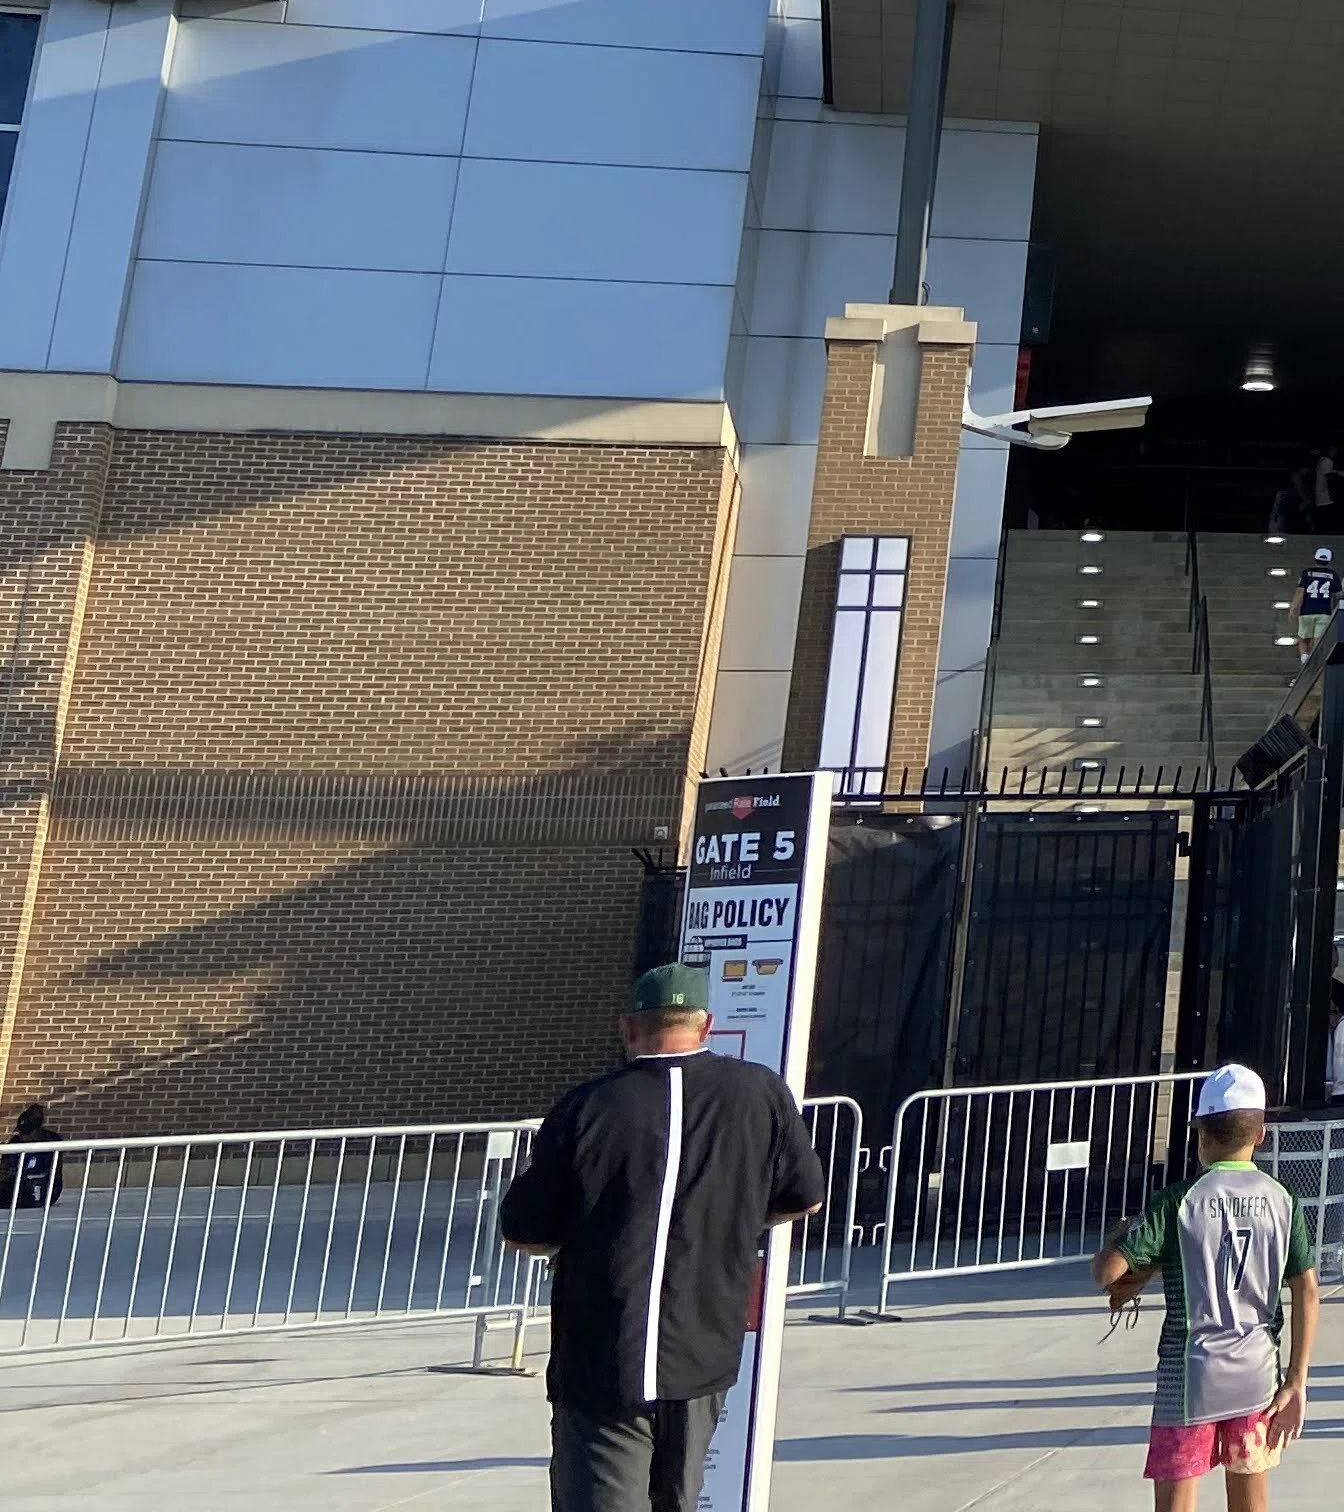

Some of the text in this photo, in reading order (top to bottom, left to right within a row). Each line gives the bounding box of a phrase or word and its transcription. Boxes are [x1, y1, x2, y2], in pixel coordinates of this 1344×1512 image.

[1306, 579, 1331, 599] 44
[753, 794, 780, 807] Field
[695, 830, 795, 865] GATE 5
[710, 863, 753, 881] Infield
[688, 897, 790, 930] BAG POLICY
[1223, 1226, 1253, 1293] 17
